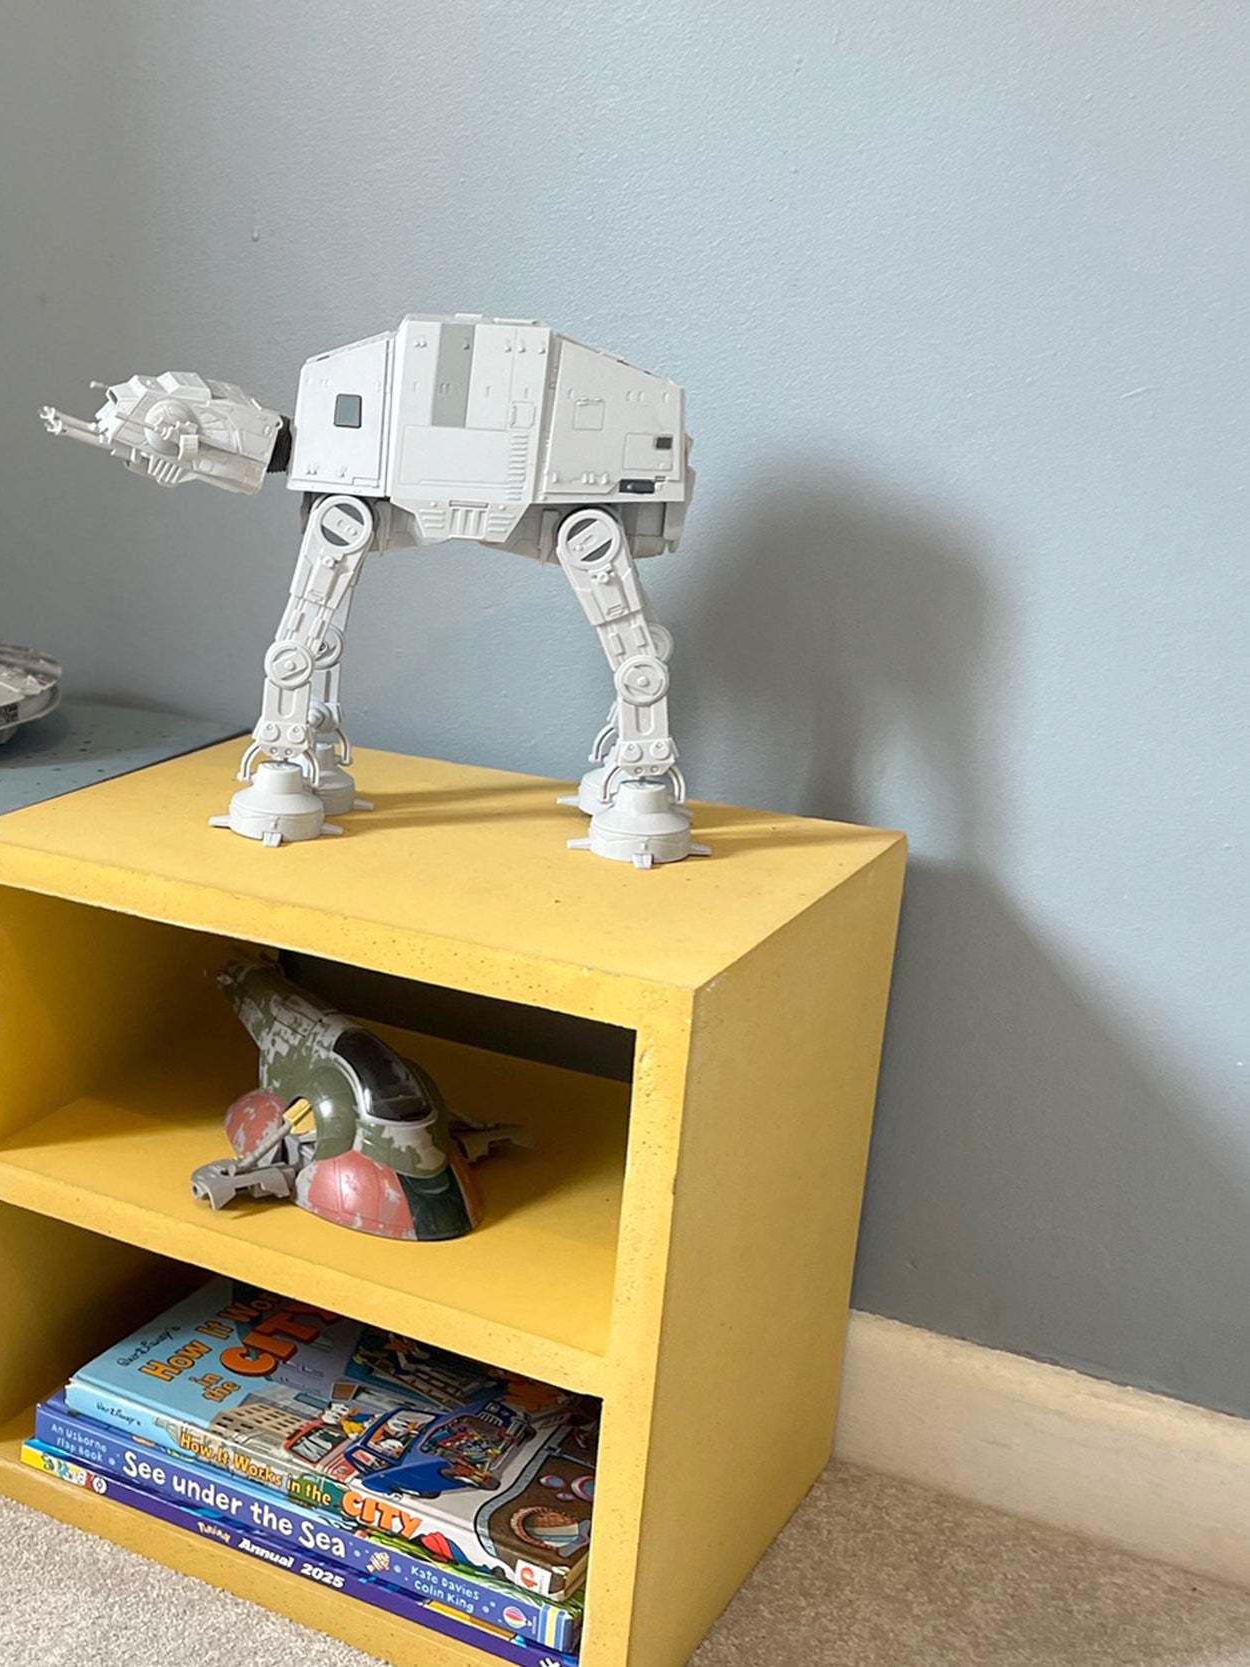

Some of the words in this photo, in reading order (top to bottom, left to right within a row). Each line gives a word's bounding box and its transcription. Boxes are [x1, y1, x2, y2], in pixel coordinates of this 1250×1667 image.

[138, 1339, 212, 1383] How
[195, 1319, 235, 1341] It
[189, 1372, 223, 1388] in
[202, 1380, 241, 1404] the
[51, 1423, 65, 1435] An
[65, 1428, 108, 1453] Usborne
[180, 1430, 214, 1459] How
[216, 1445, 230, 1465] It
[233, 1451, 282, 1487] Works
[287, 1473, 301, 1494] in
[305, 1481, 332, 1506] the
[123, 1450, 167, 1486] See
[172, 1475, 243, 1515] under
[250, 1504, 294, 1536] the
[298, 1521, 347, 1559] Sea
[341, 1490, 423, 1540] CITY
[238, 1537, 295, 1569] Annual
[300, 1563, 346, 1589] 2025
[410, 1565, 438, 1585] Kate
[441, 1577, 481, 1601] Davies
[414, 1580, 445, 1599] Colin
[447, 1592, 475, 1613] King
